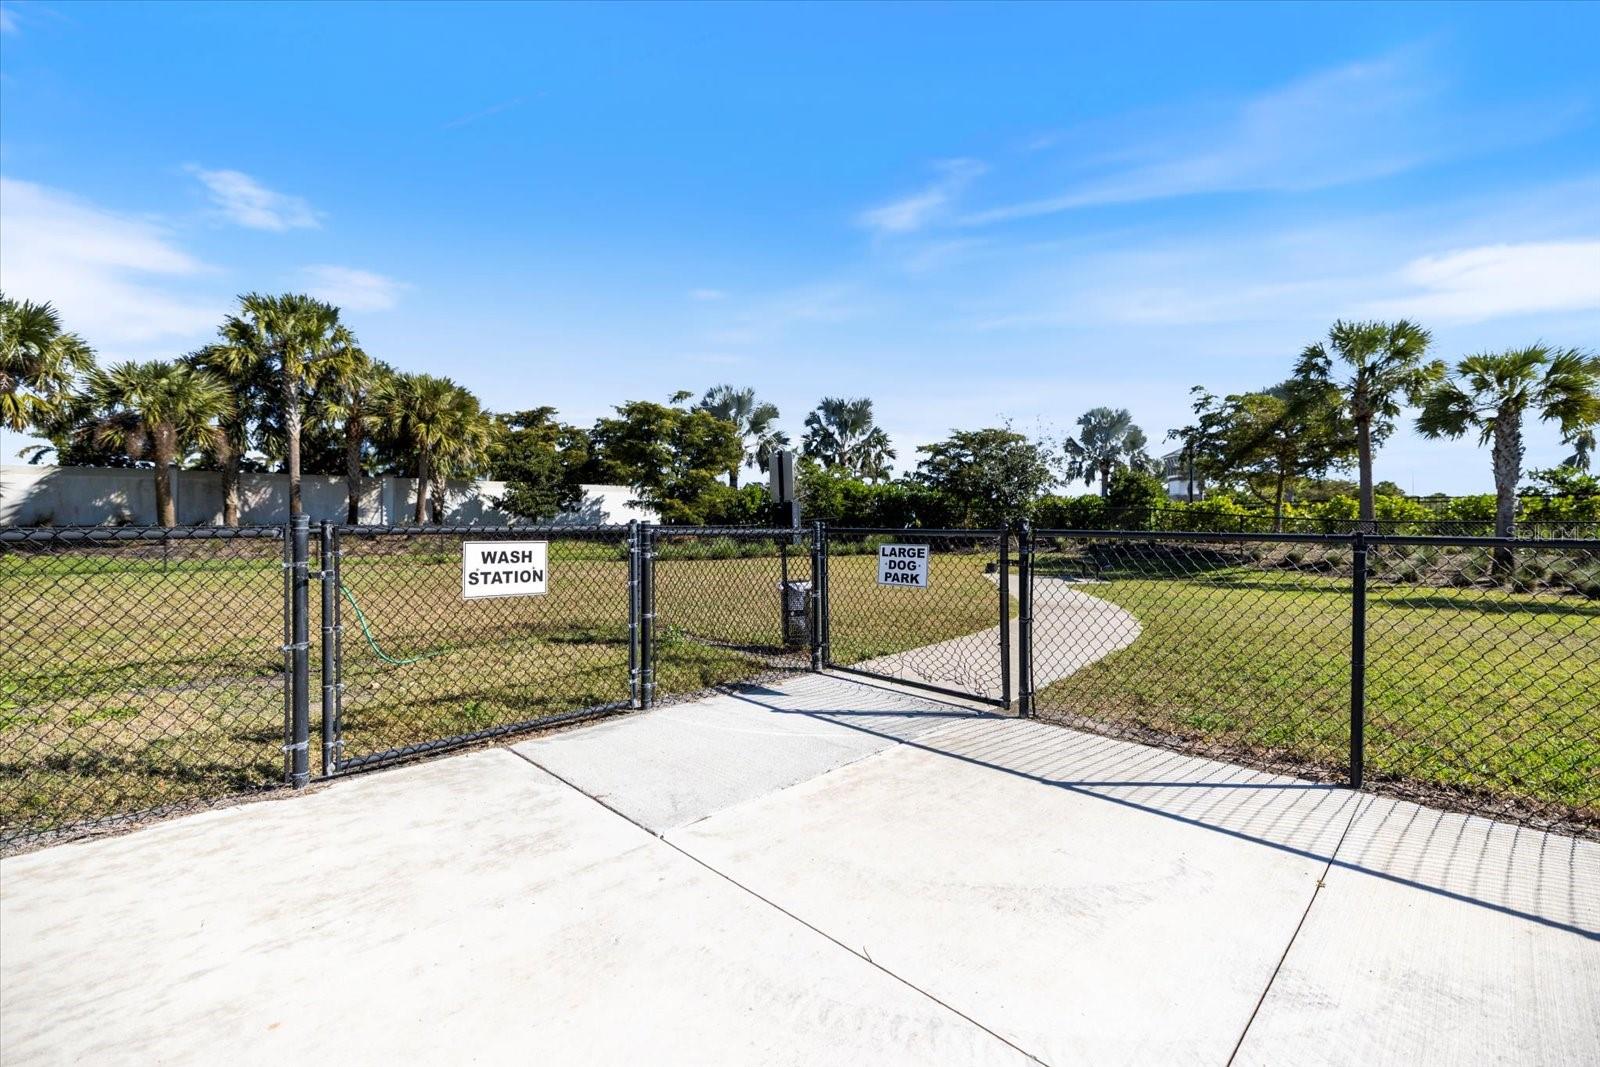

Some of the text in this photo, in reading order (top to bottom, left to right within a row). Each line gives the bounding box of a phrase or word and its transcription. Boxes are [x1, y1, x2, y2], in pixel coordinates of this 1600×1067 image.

[481, 550, 532, 564] WASH
[882, 547, 925, 558] LARGE
[889, 560, 916, 571] DOG
[468, 570, 543, 585] STATION
[885, 572, 920, 584] PARK
